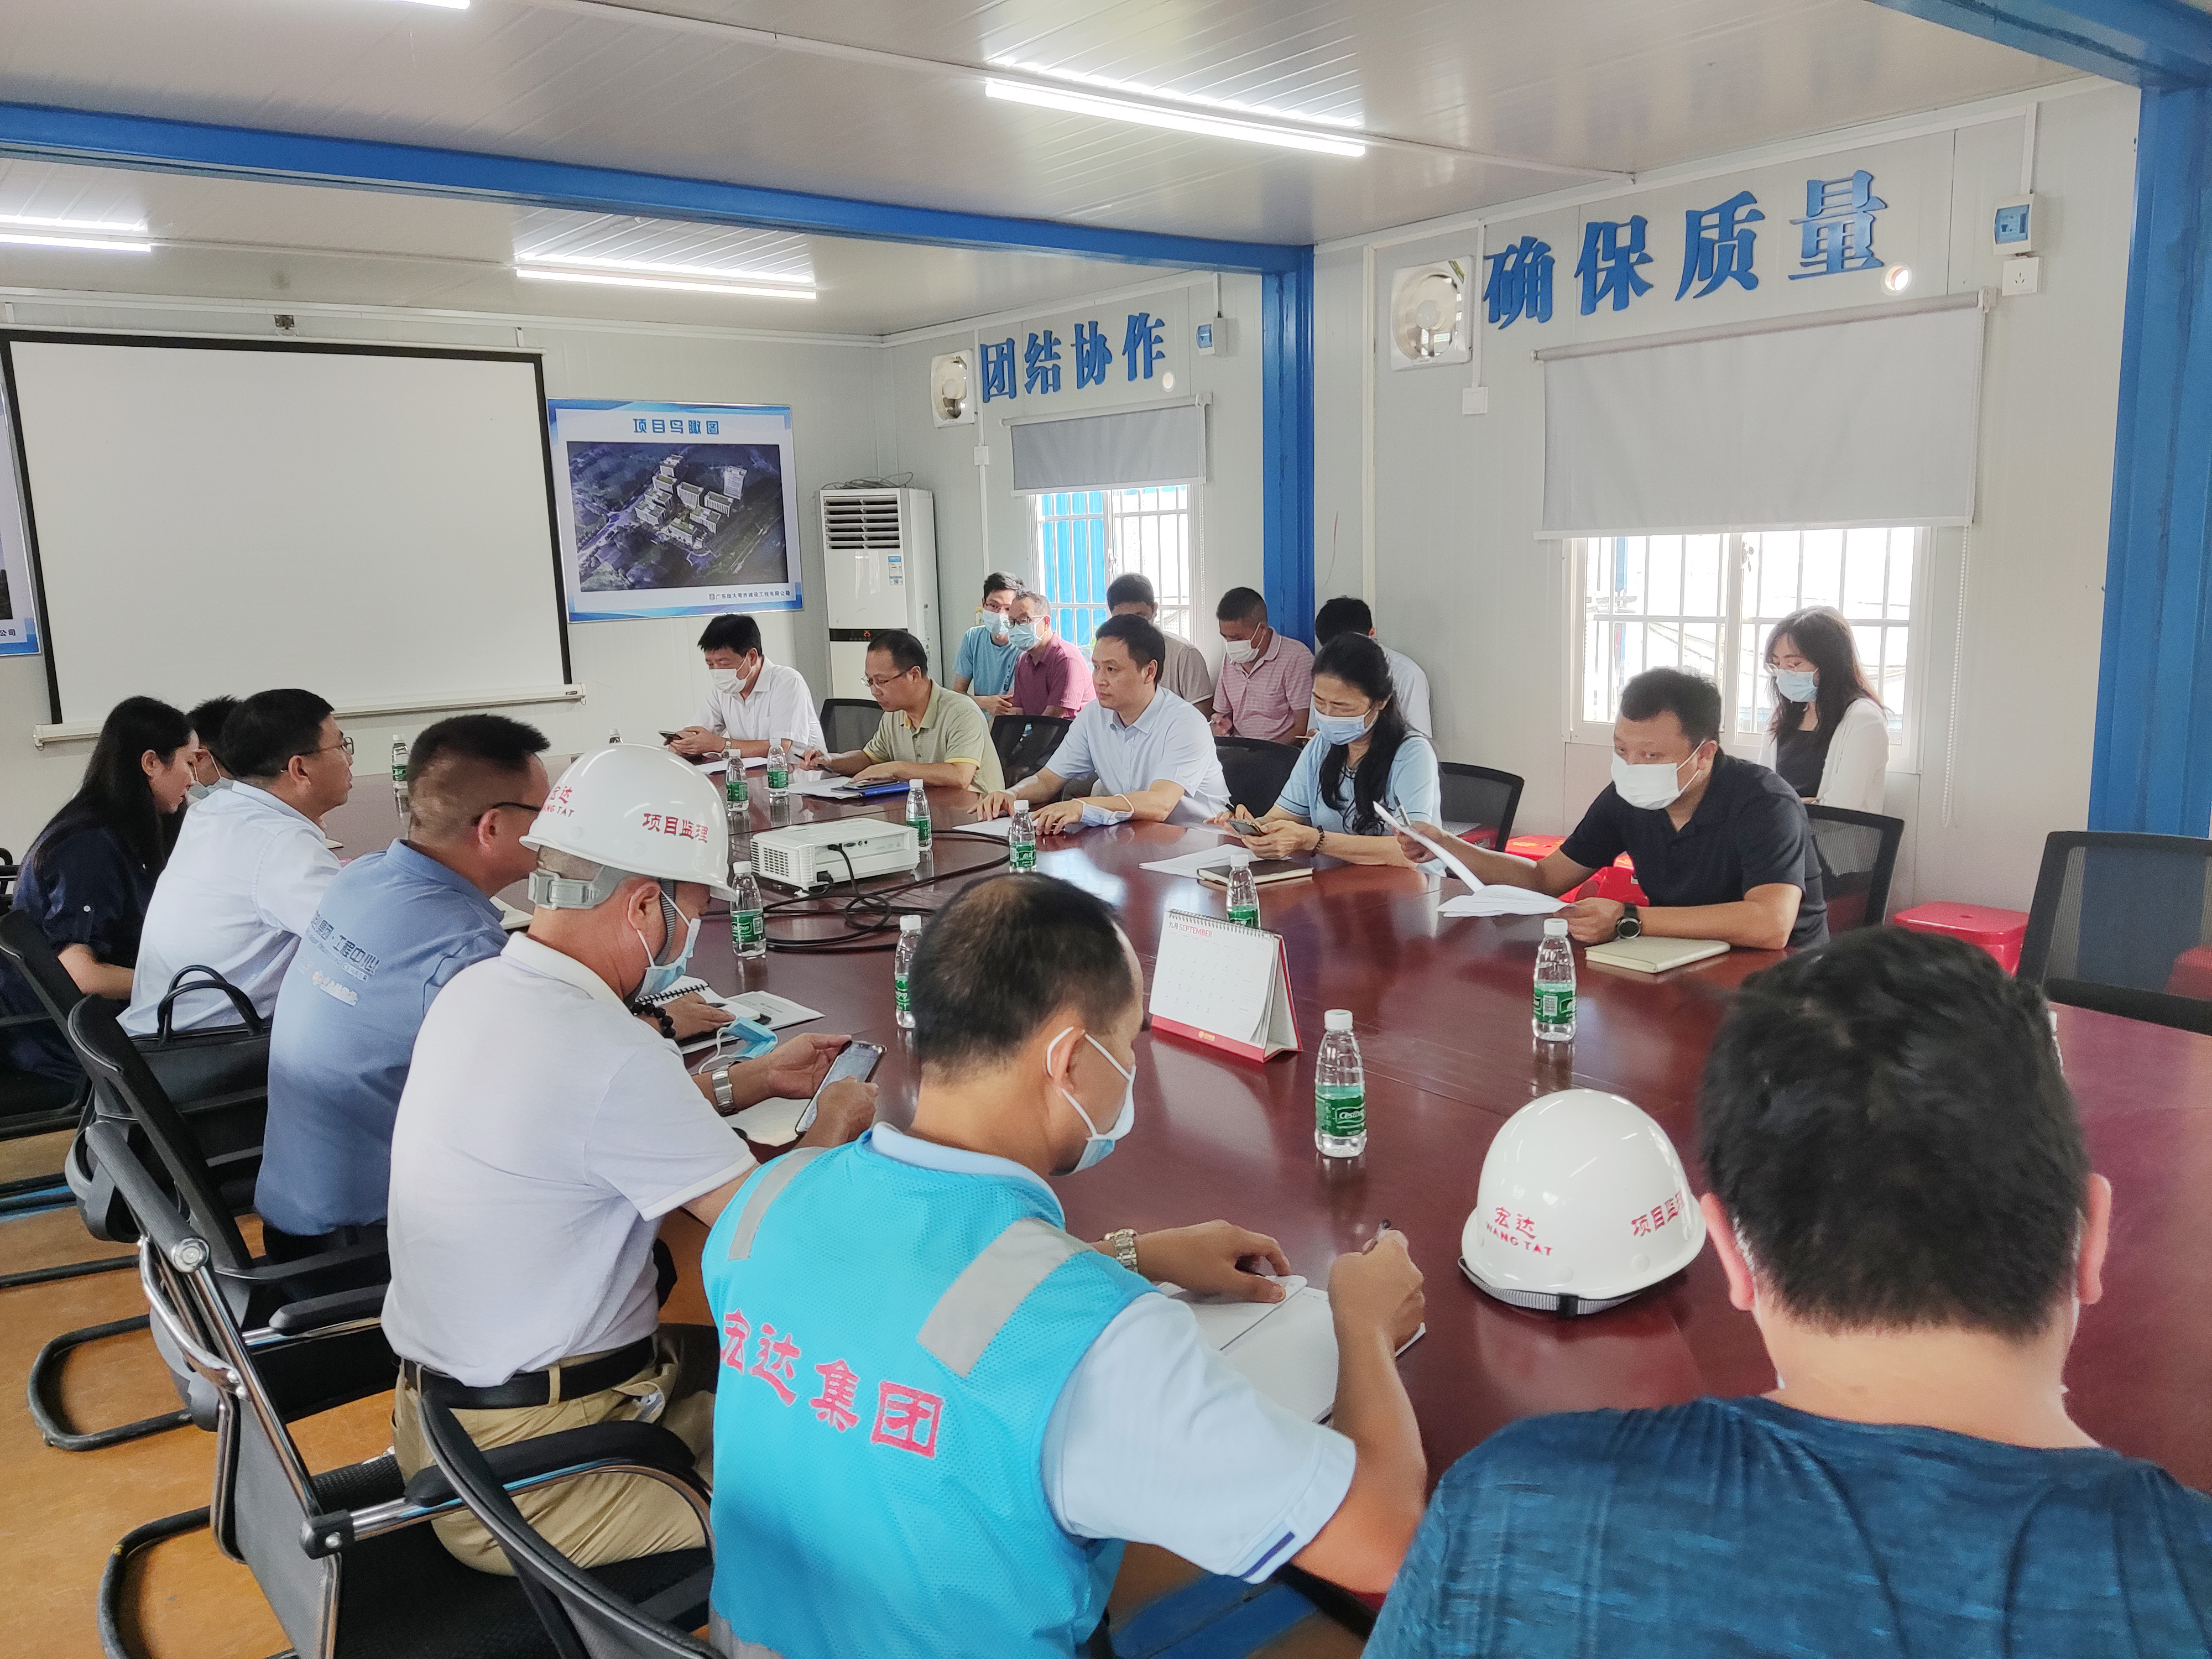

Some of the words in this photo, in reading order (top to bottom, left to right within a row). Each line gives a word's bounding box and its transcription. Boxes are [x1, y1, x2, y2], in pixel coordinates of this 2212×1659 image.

[1483, 169, 1887, 330] 确保质量
[980, 312, 1165, 403] 团结协作
[633, 419, 719, 435] 项目鸟瞰图
[642, 812, 709, 843] 项目监理
[1168, 921, 1178, 930] 九月
[1179, 924, 1212, 938] SEPTEMBER
[1495, 1207, 1537, 1240] 宏达
[1524, 1241, 1553, 1256] TAT
[721, 1309, 945, 1459] 宏达集团
